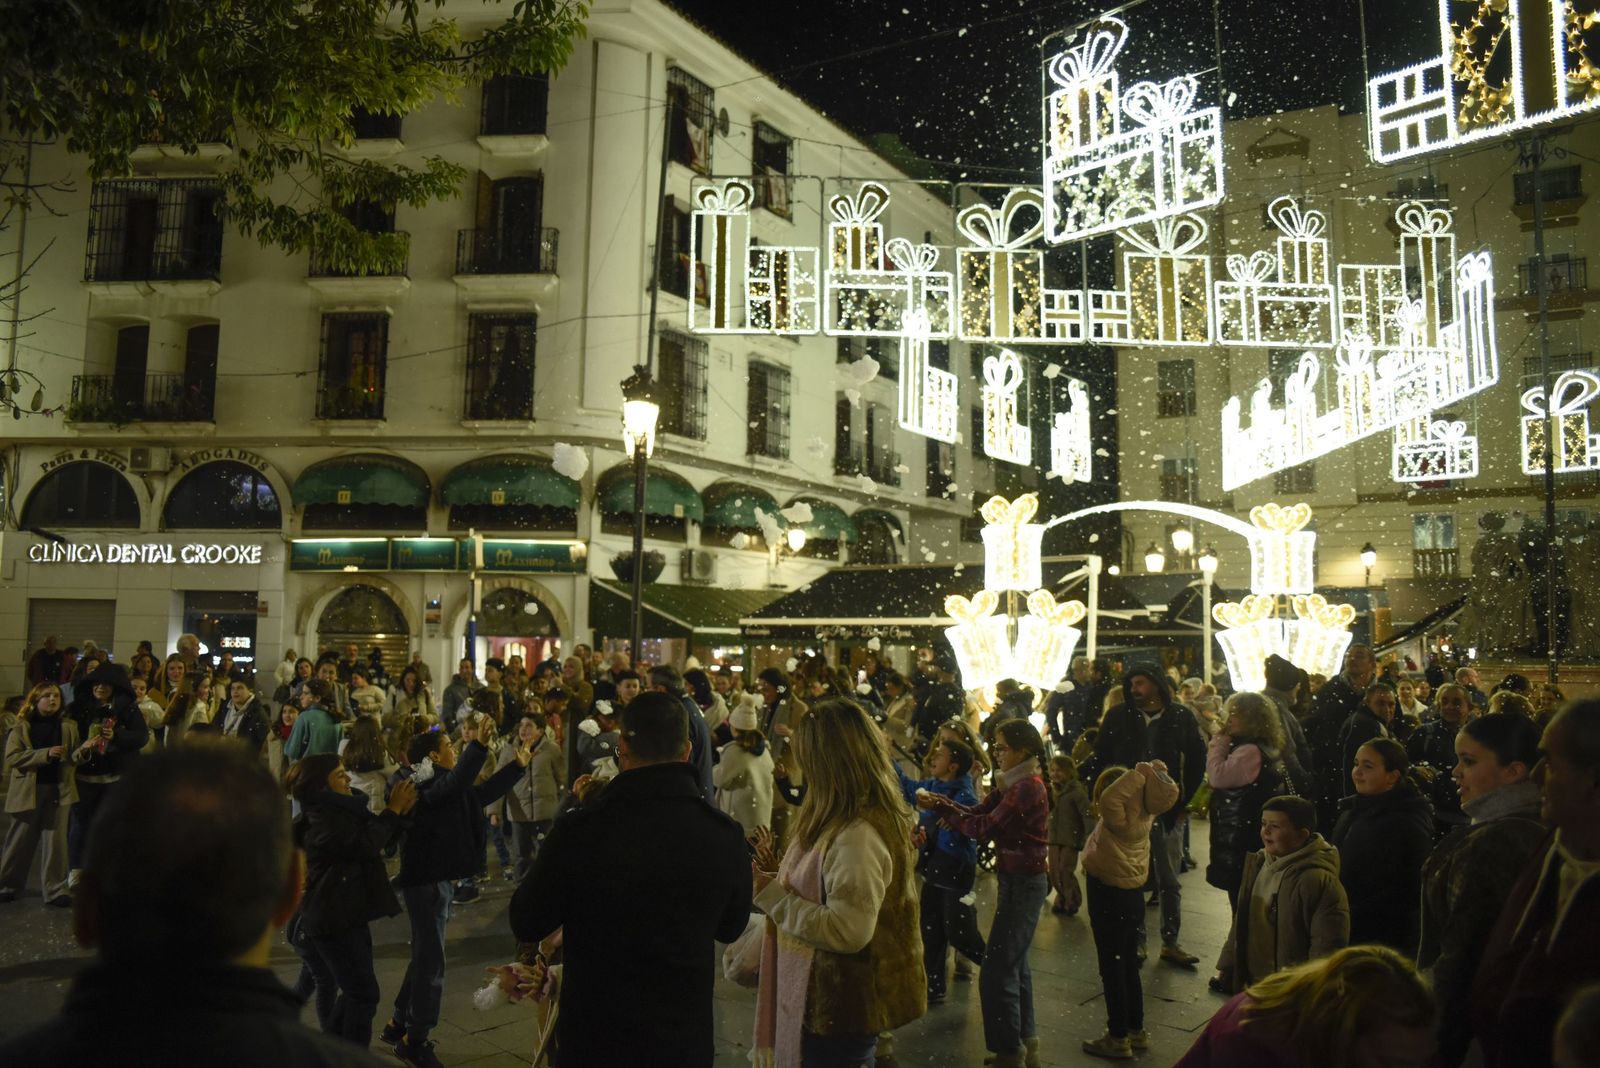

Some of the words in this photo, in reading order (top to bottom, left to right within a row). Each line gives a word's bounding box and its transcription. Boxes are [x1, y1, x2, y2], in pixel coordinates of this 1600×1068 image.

[28, 541, 103, 563] CLÍNICA
[106, 543, 177, 563] DENTAL
[180, 543, 263, 563] CROOKE
